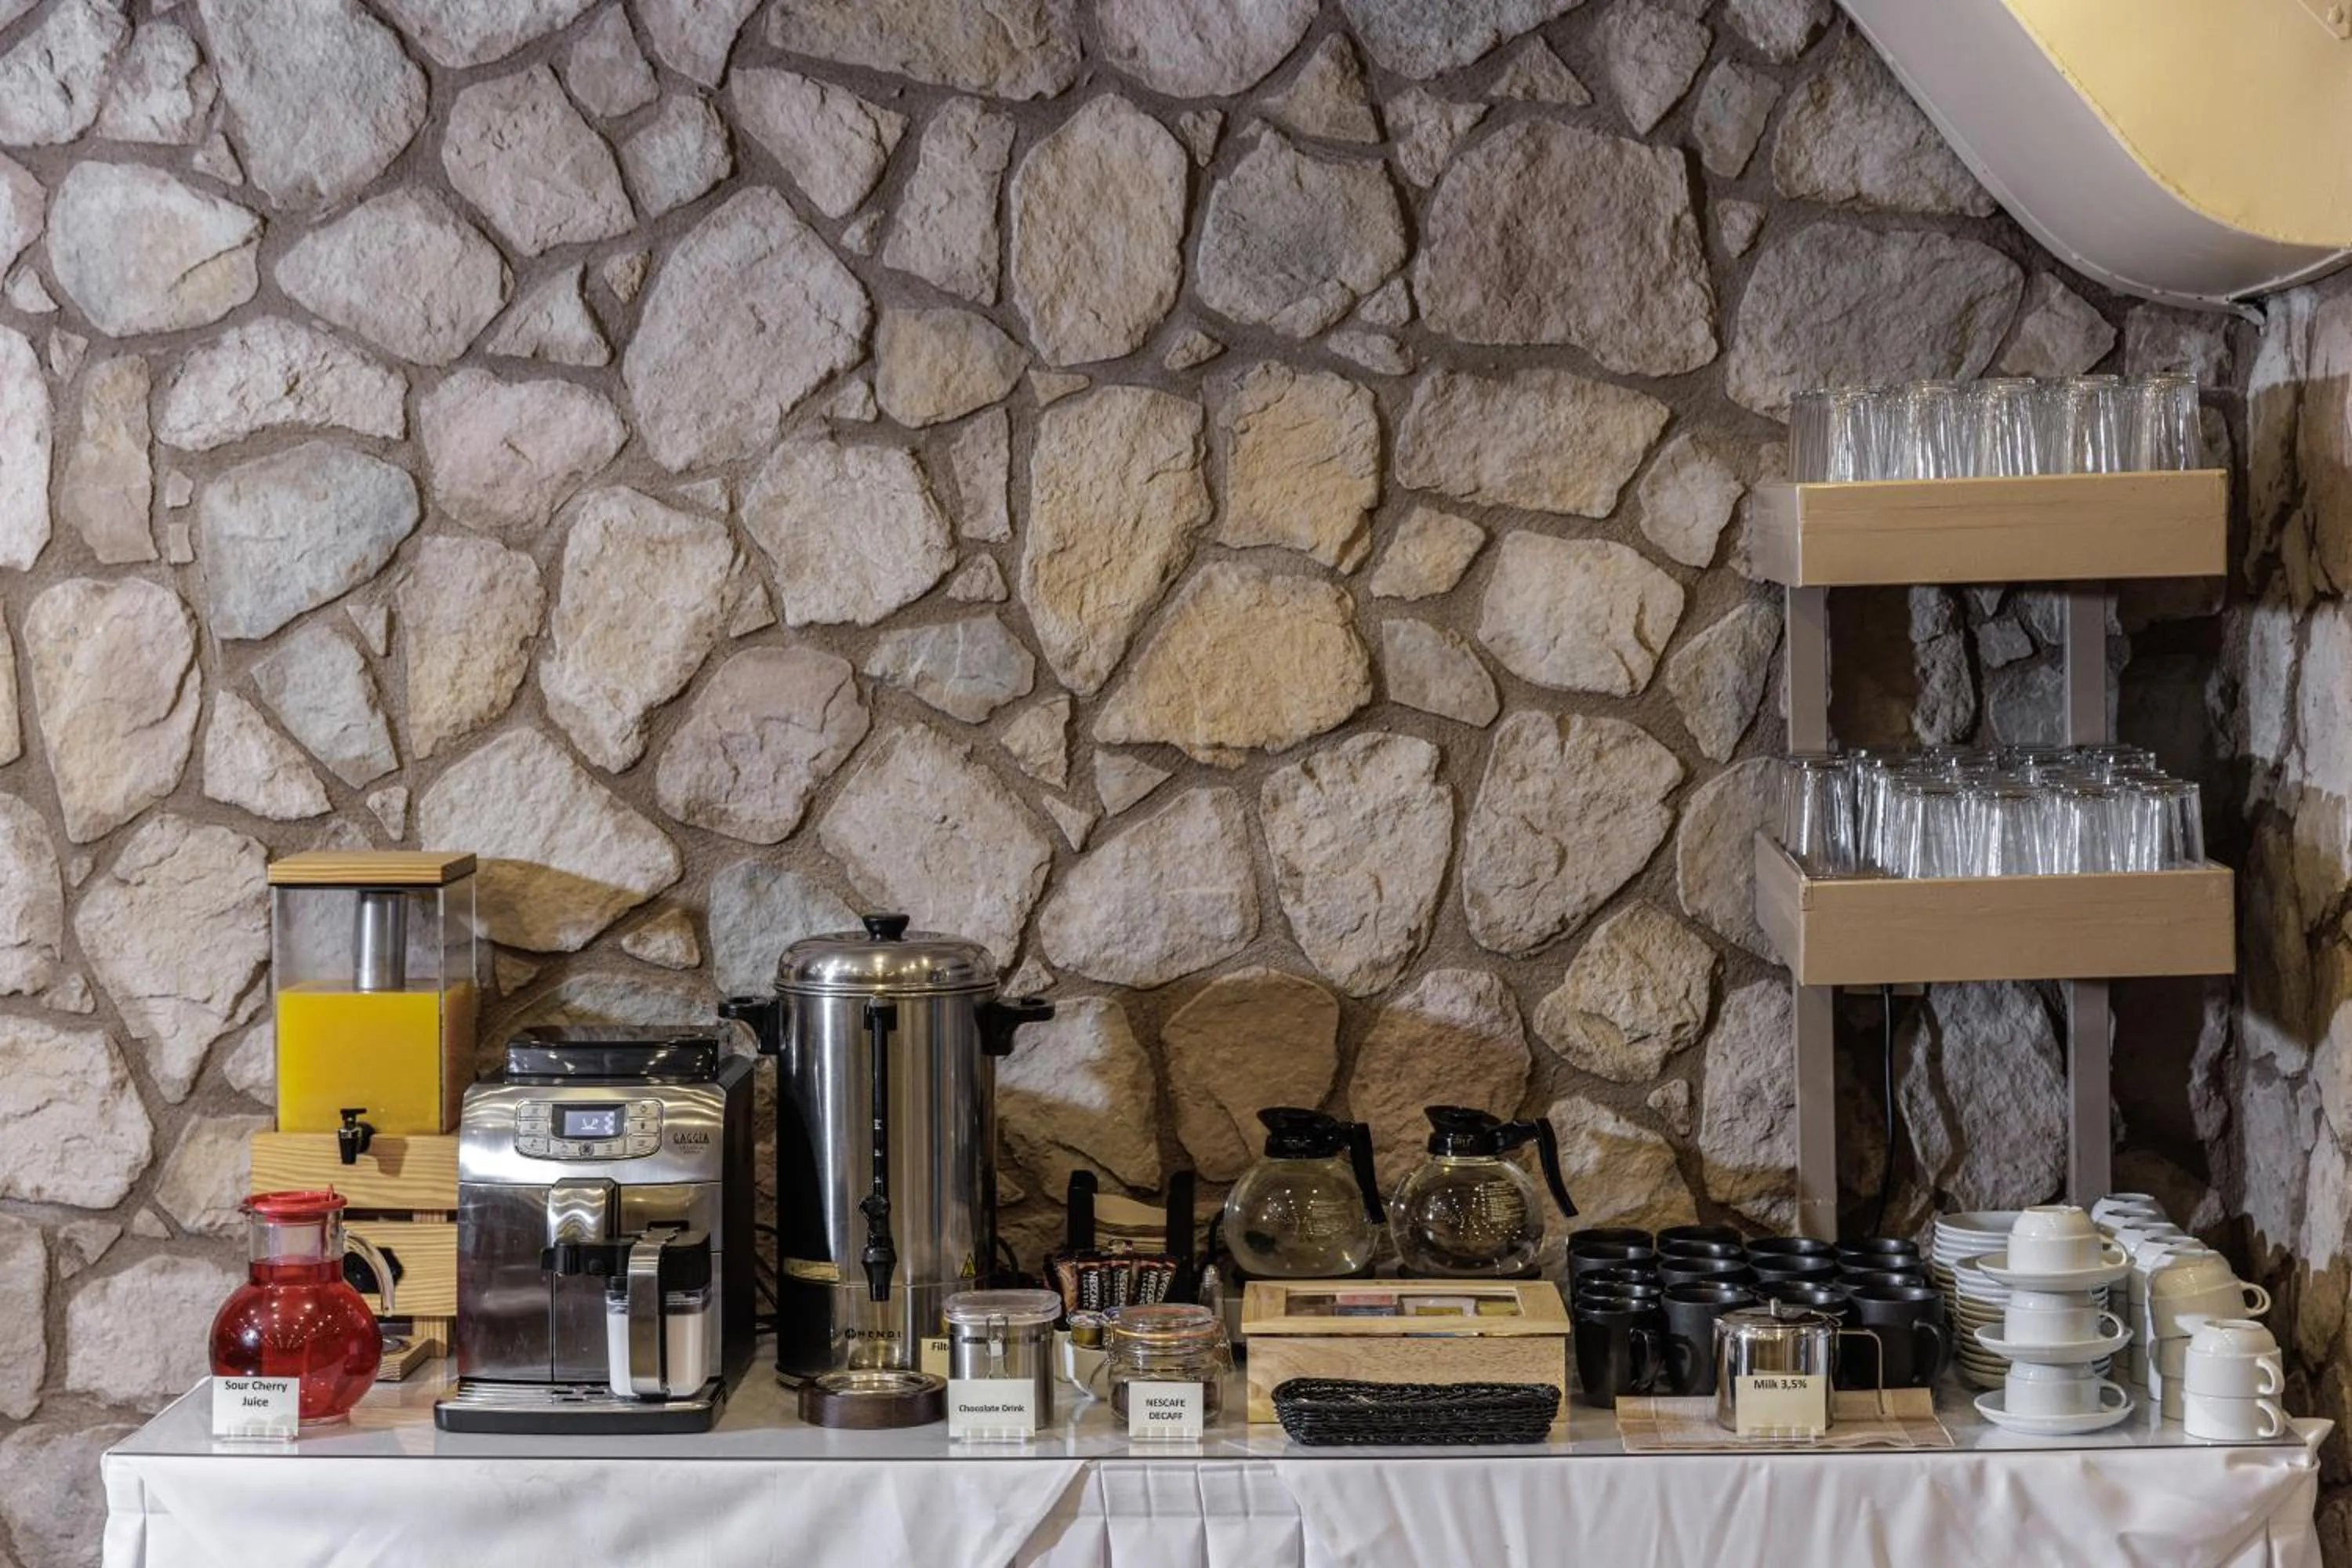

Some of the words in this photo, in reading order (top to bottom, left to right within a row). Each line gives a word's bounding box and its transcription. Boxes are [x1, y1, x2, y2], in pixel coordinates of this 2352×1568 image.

[673, 1132, 710, 1144] GAGGIA
[931, 1341, 948, 1351] Filt
[225, 1380, 249, 1390] Sour
[252, 1381, 288, 1392] Cherry
[1754, 1379, 1778, 1389] Milk
[1781, 1379, 1807, 1390] 3,5%
[241, 1396, 269, 1407] Juice
[1145, 1399, 1186, 1407] NESCAFE
